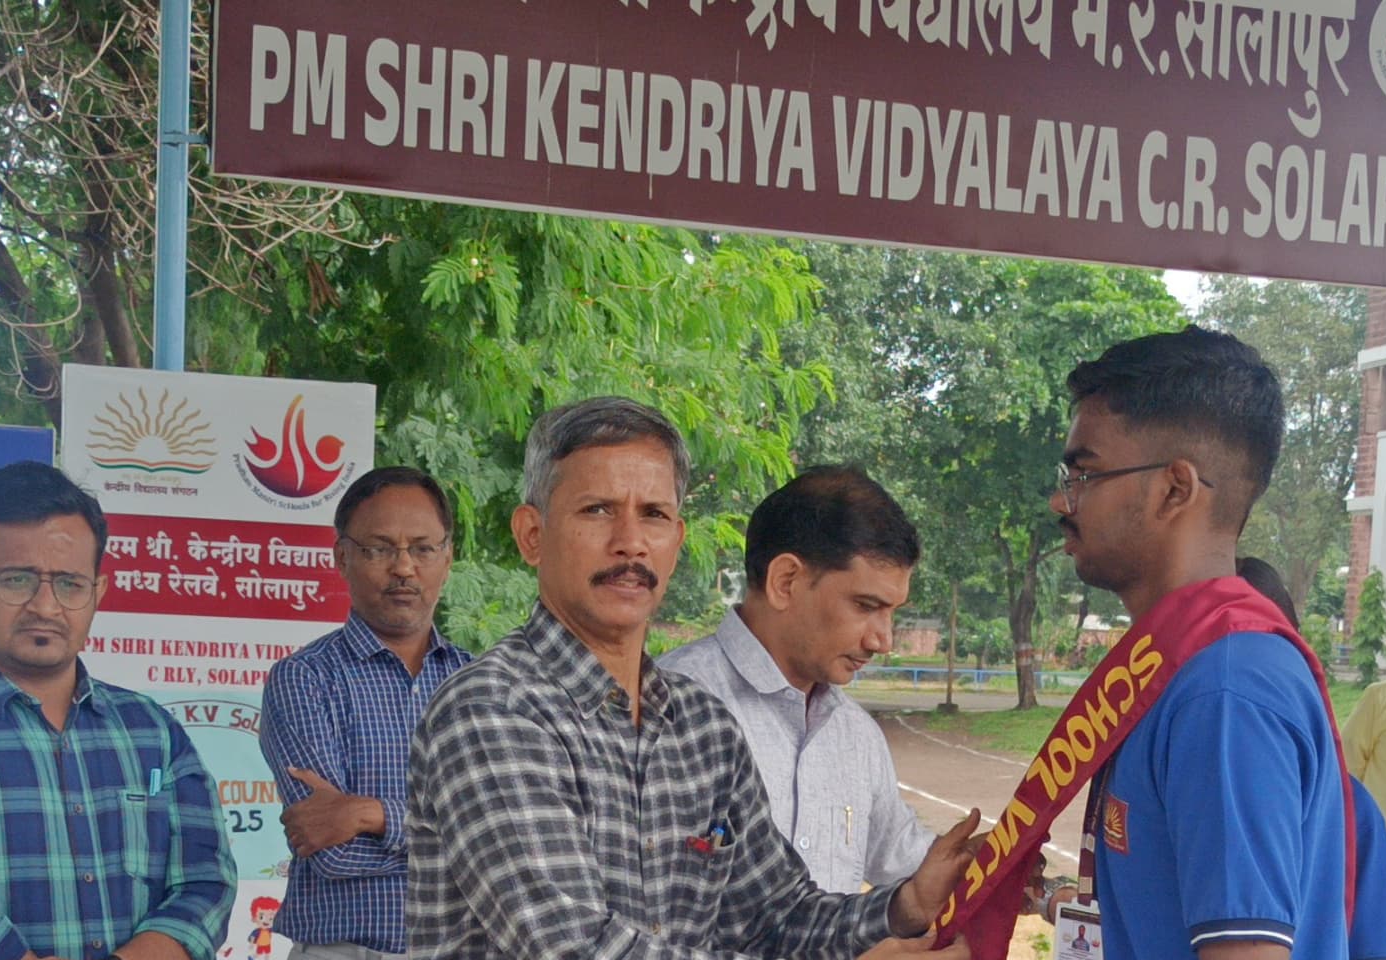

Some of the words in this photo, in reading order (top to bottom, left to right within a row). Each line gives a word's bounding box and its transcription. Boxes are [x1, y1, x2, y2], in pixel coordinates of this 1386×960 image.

[250, 24, 347, 140] PM
[364, 37, 509, 158] SHRI
[524, 58, 817, 192] KENDRIYA
[832, 95, 1124, 224] VIDYALAYA
[1137, 130, 1229, 235] C.R.
[105, 536, 140, 560] एम
[187, 531, 262, 569] केन्द्रीय
[268, 537, 335, 569] विद्याल
[114, 569, 162, 595] मध्य
[167, 565, 227, 599] रेलवे,
[235, 569, 326, 612] सोलापुर.
[110, 637, 154, 655] SHRI
[161, 639, 250, 659] KENDRIYA
[255, 643, 305, 660] VIDY
[148, 666, 159, 682] C
[164, 666, 202, 686] RLY,
[1025, 633, 1163, 801] SCHOOL
[219, 780, 282, 805] COUN
